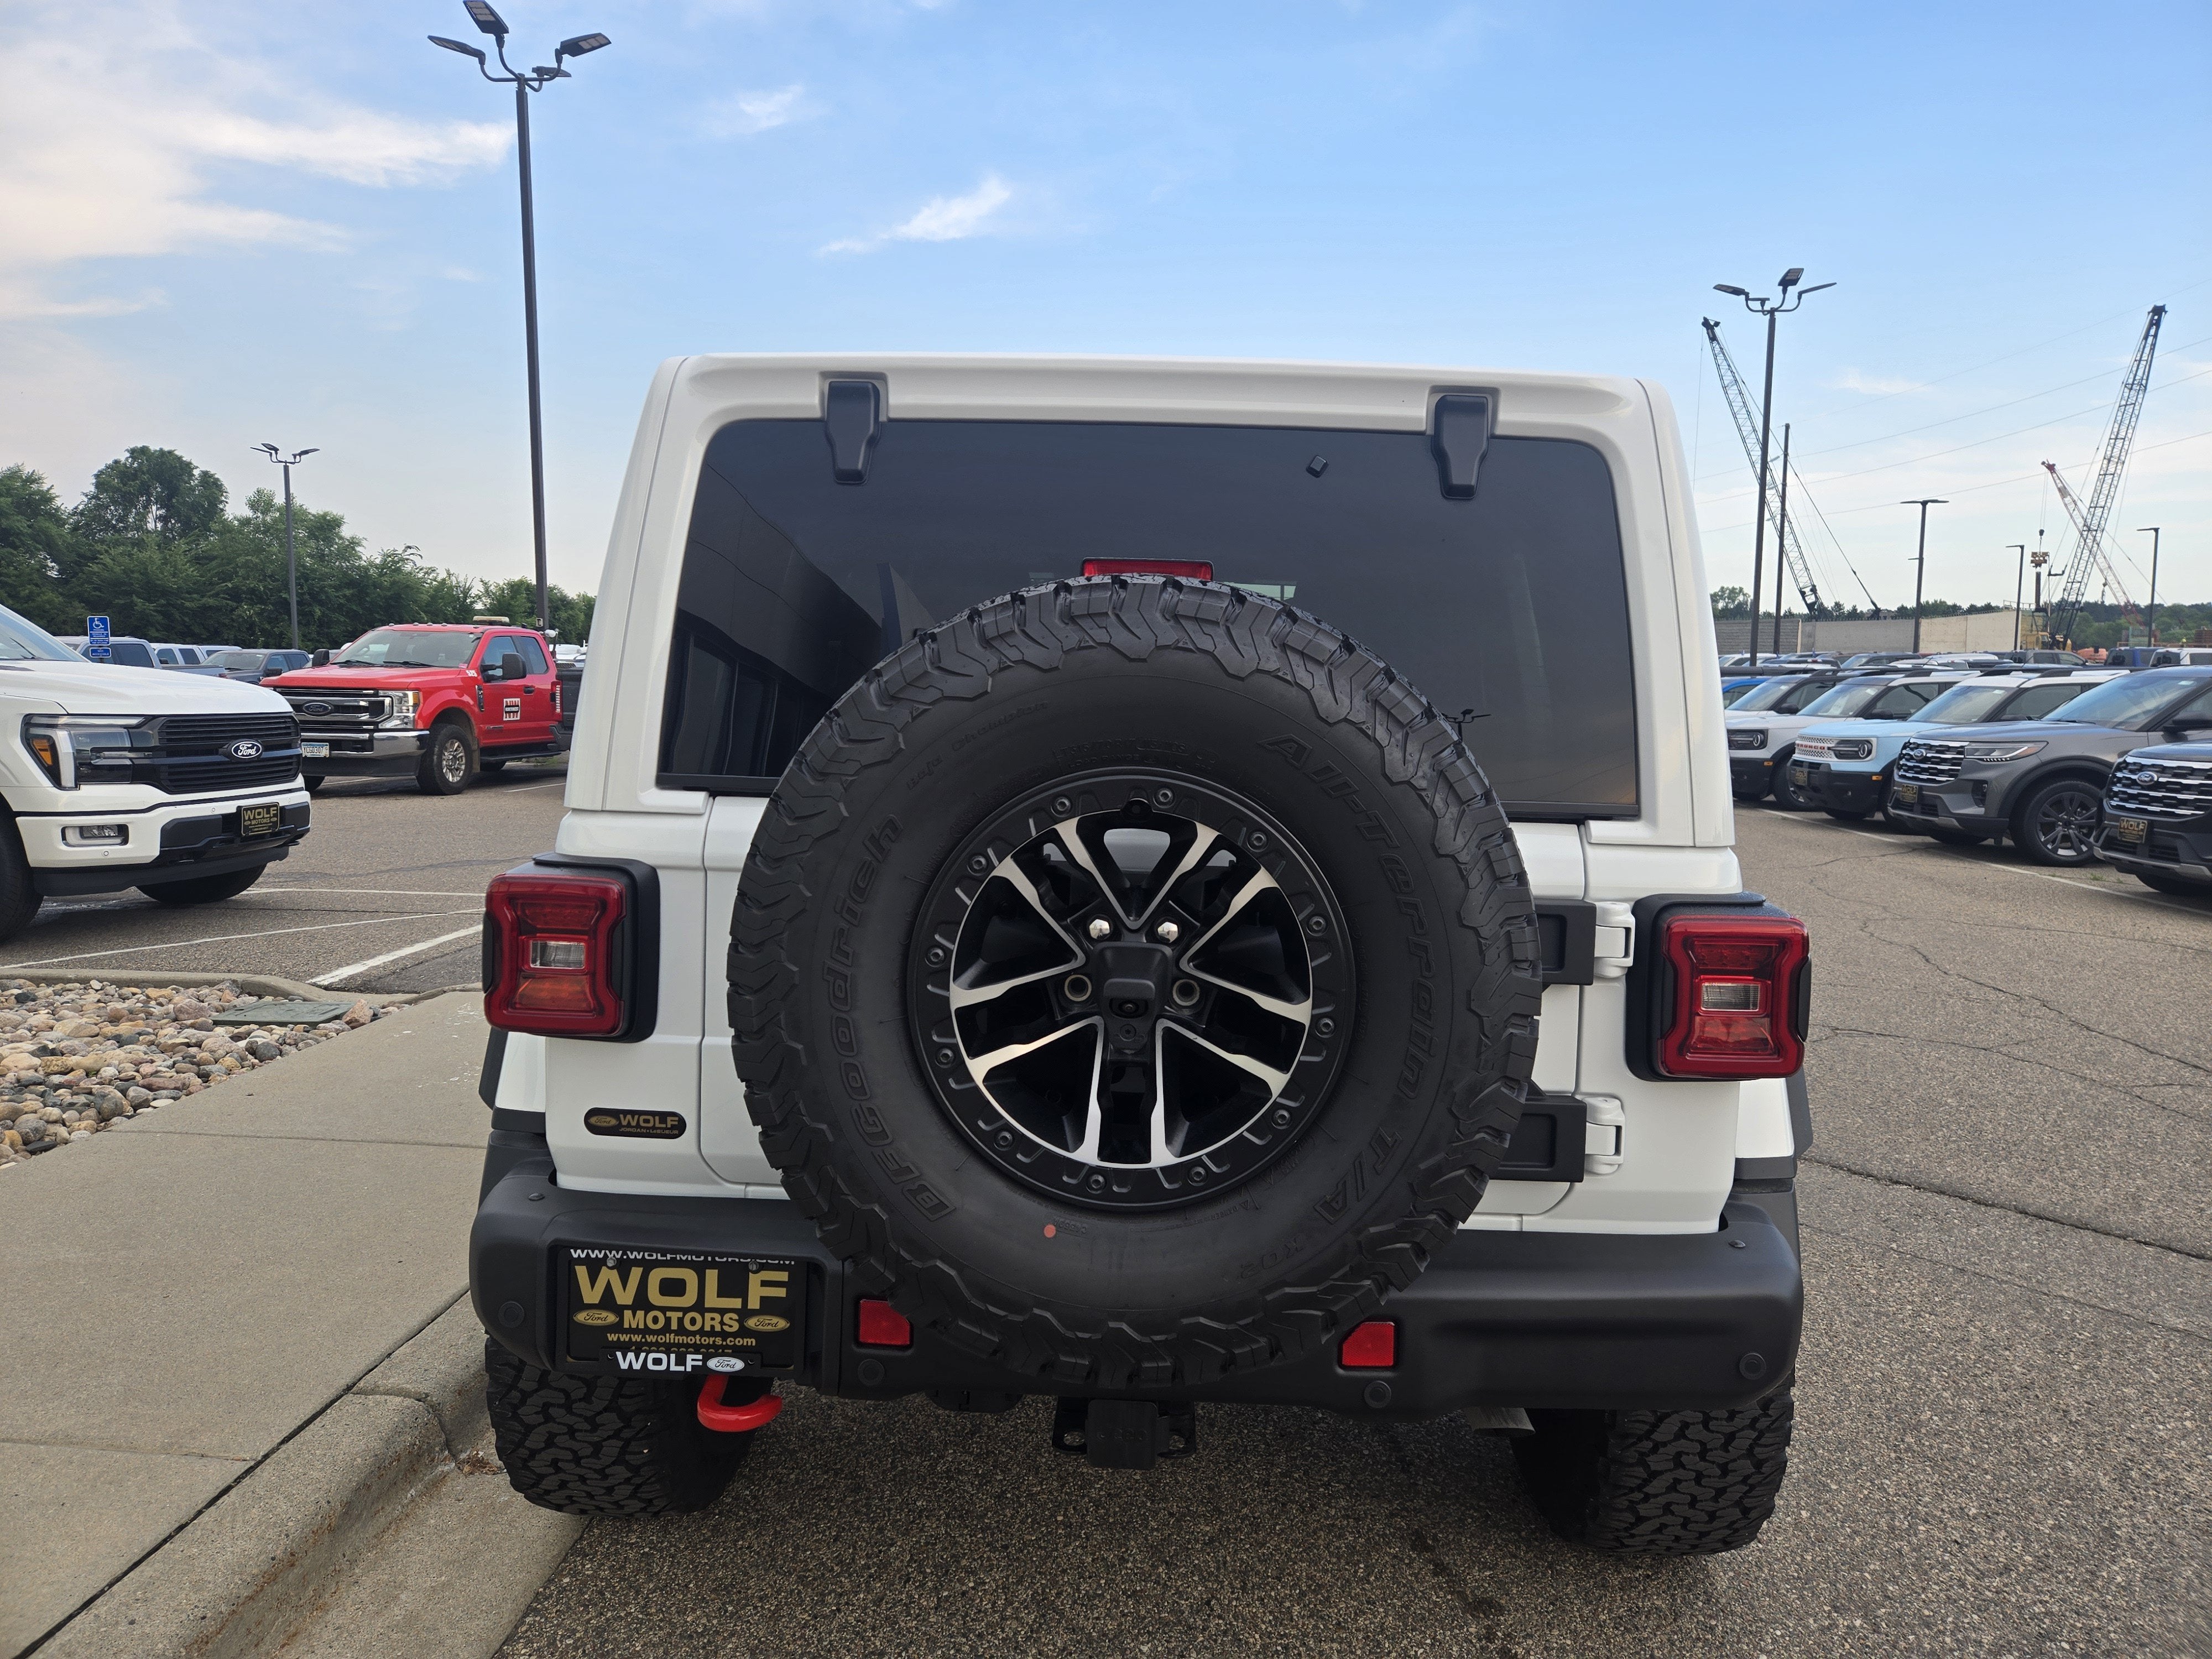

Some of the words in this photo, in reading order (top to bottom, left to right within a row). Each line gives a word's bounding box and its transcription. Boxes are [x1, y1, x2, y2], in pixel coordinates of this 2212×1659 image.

[238, 744, 257, 756] Ford
[243, 807, 277, 820] WOLF
[2121, 819, 2145, 830] WOLF
[822, 813, 956, 1222] BFGoodrich
[619, 1114, 679, 1128] WOLF
[575, 1265, 789, 1310] WOLF
[623, 1310, 739, 1332] MOTORS
[607, 1333, 756, 1346] www.wolfmotors.com
[615, 1351, 703, 1371] WOLF
[714, 1359, 737, 1369] Ford
